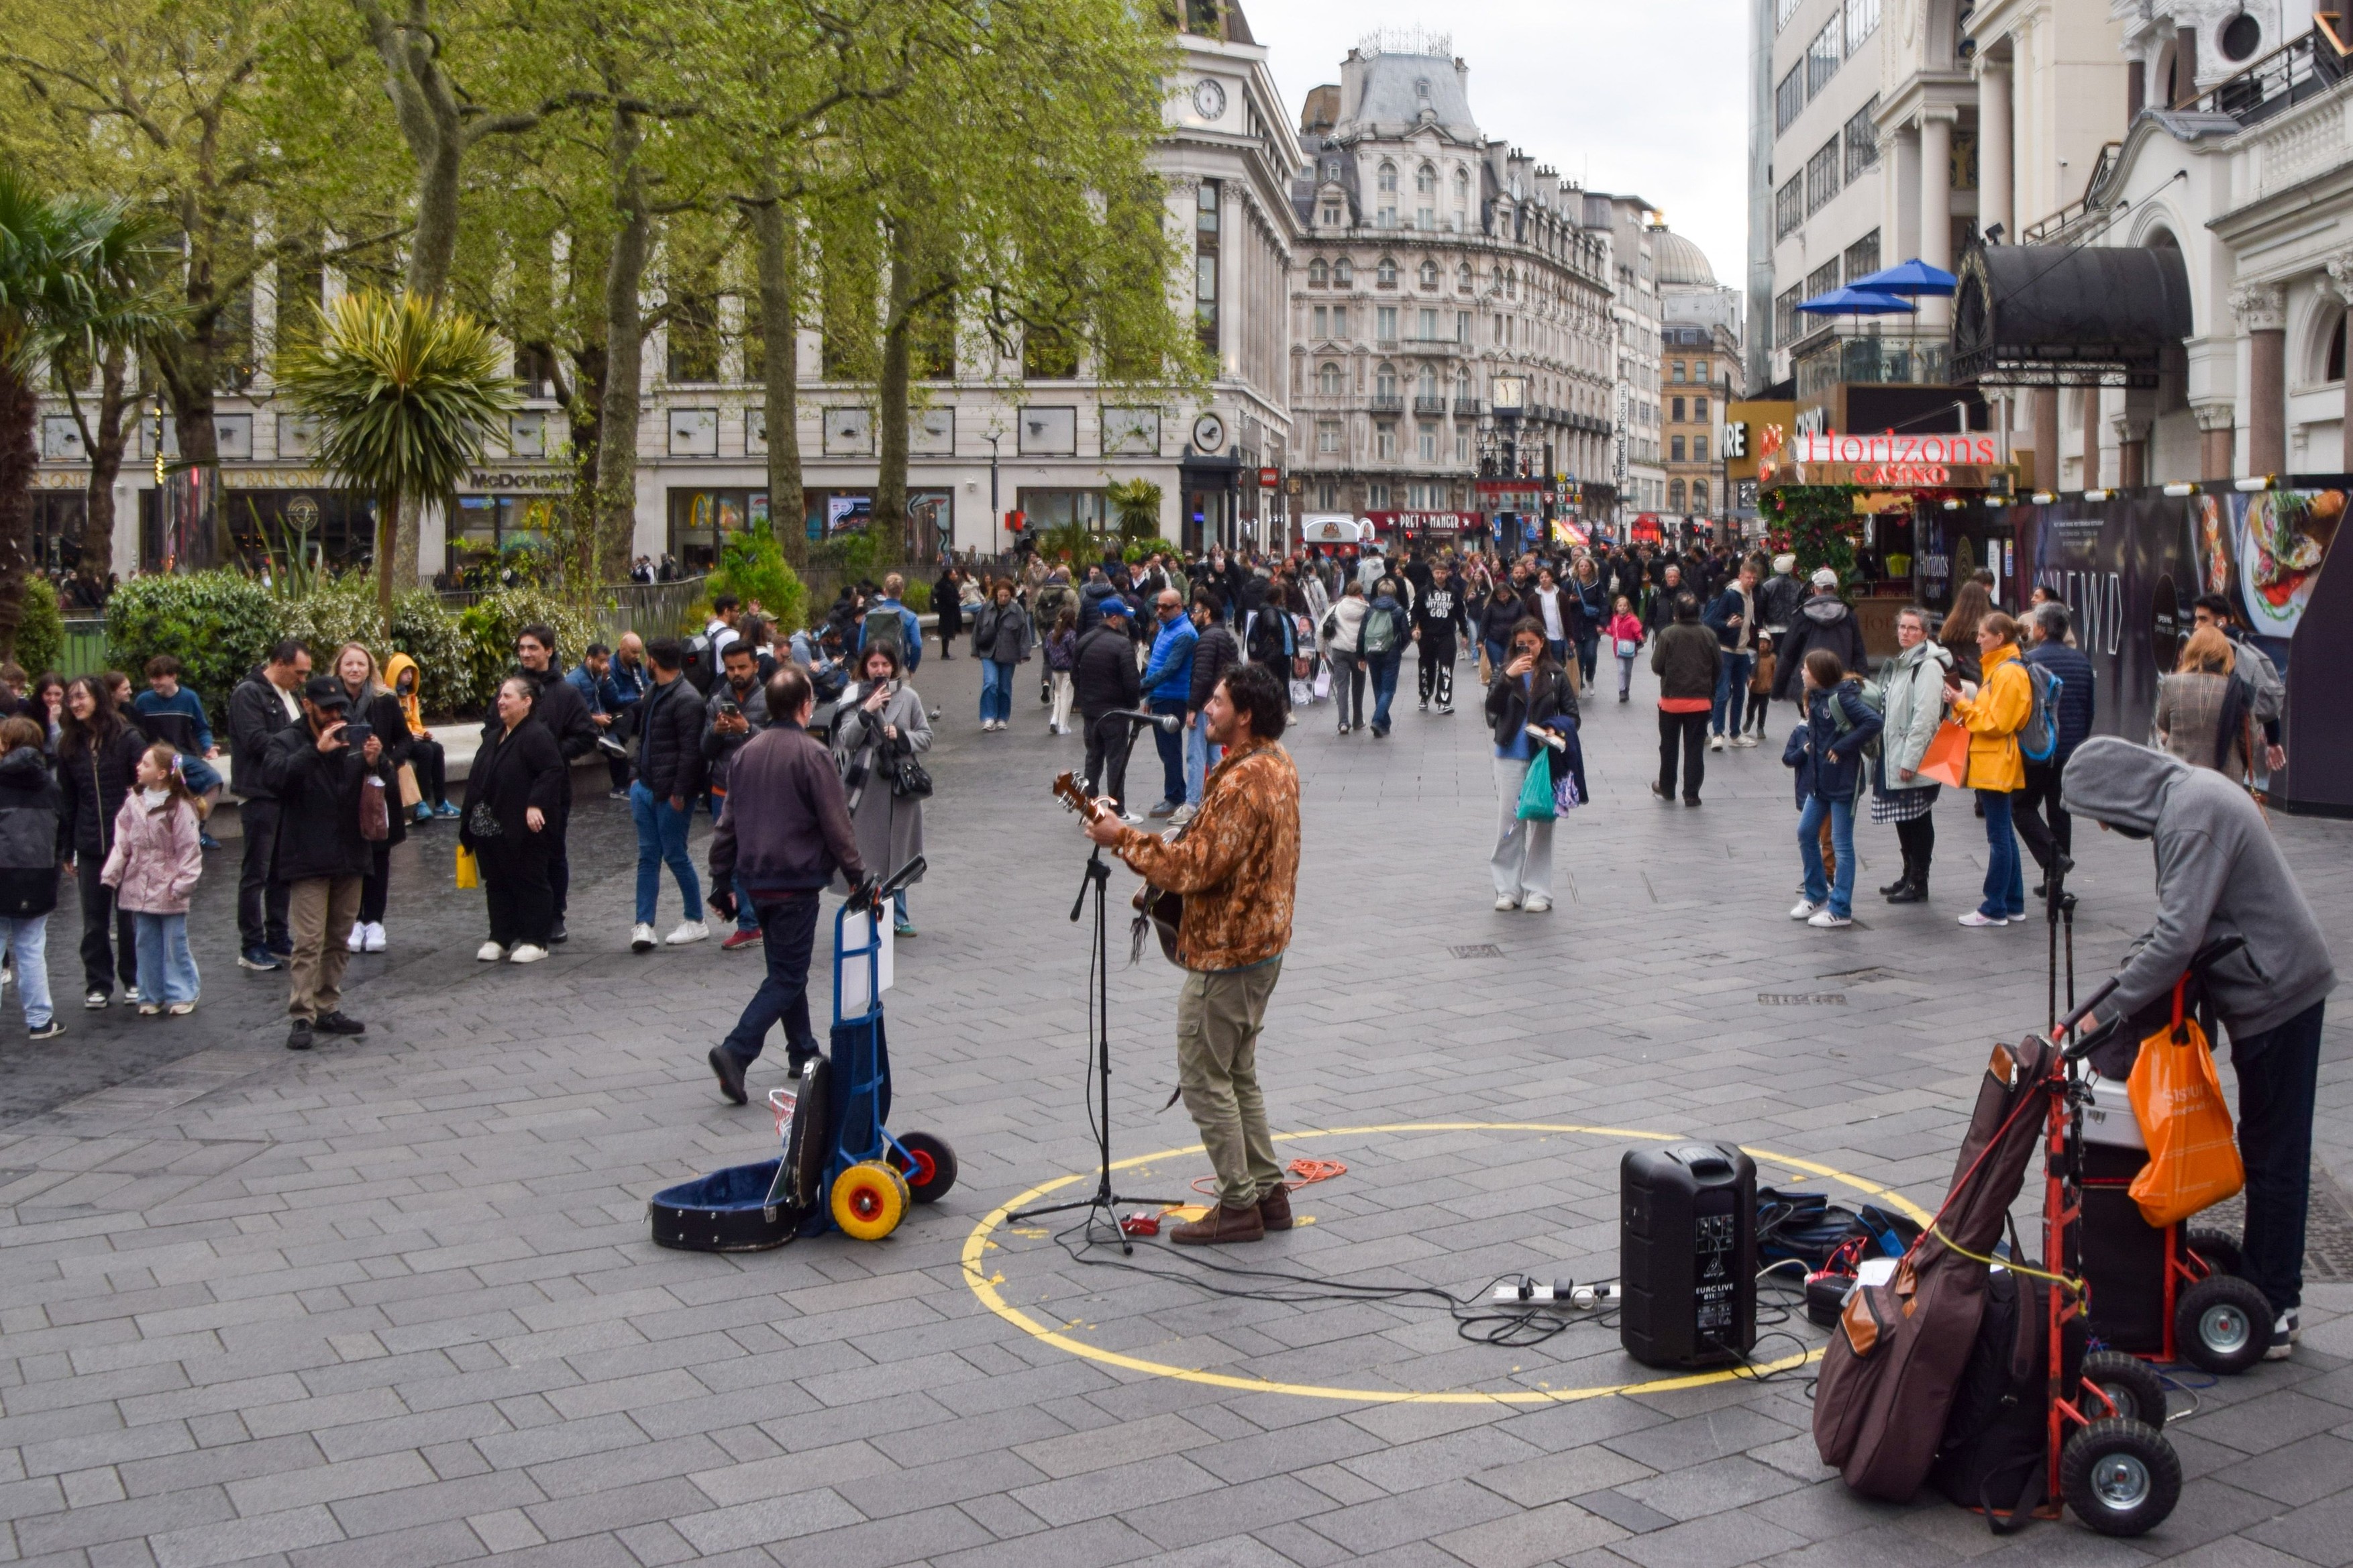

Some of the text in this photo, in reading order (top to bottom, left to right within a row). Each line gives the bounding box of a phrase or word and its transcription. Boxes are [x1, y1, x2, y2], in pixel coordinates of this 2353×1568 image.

[1795, 407, 1823, 437] CASINO
[1807, 427, 1994, 465] Horizons
[50, 472, 87, 488] ONE
[247, 471, 278, 486] BAR
[286, 471, 325, 486] ONE
[1263, 474, 1276, 482] LEGO
[1854, 464, 1946, 484] CASINO
[1400, 515, 1420, 529] PRET
[1430, 515, 1459, 529] MANGER
[1919, 549, 1949, 578] Horizons
[1428, 592, 1452, 601] LOST
[1426, 600, 1455, 610] WITHOUT
[1430, 608, 1449, 618] GOD
